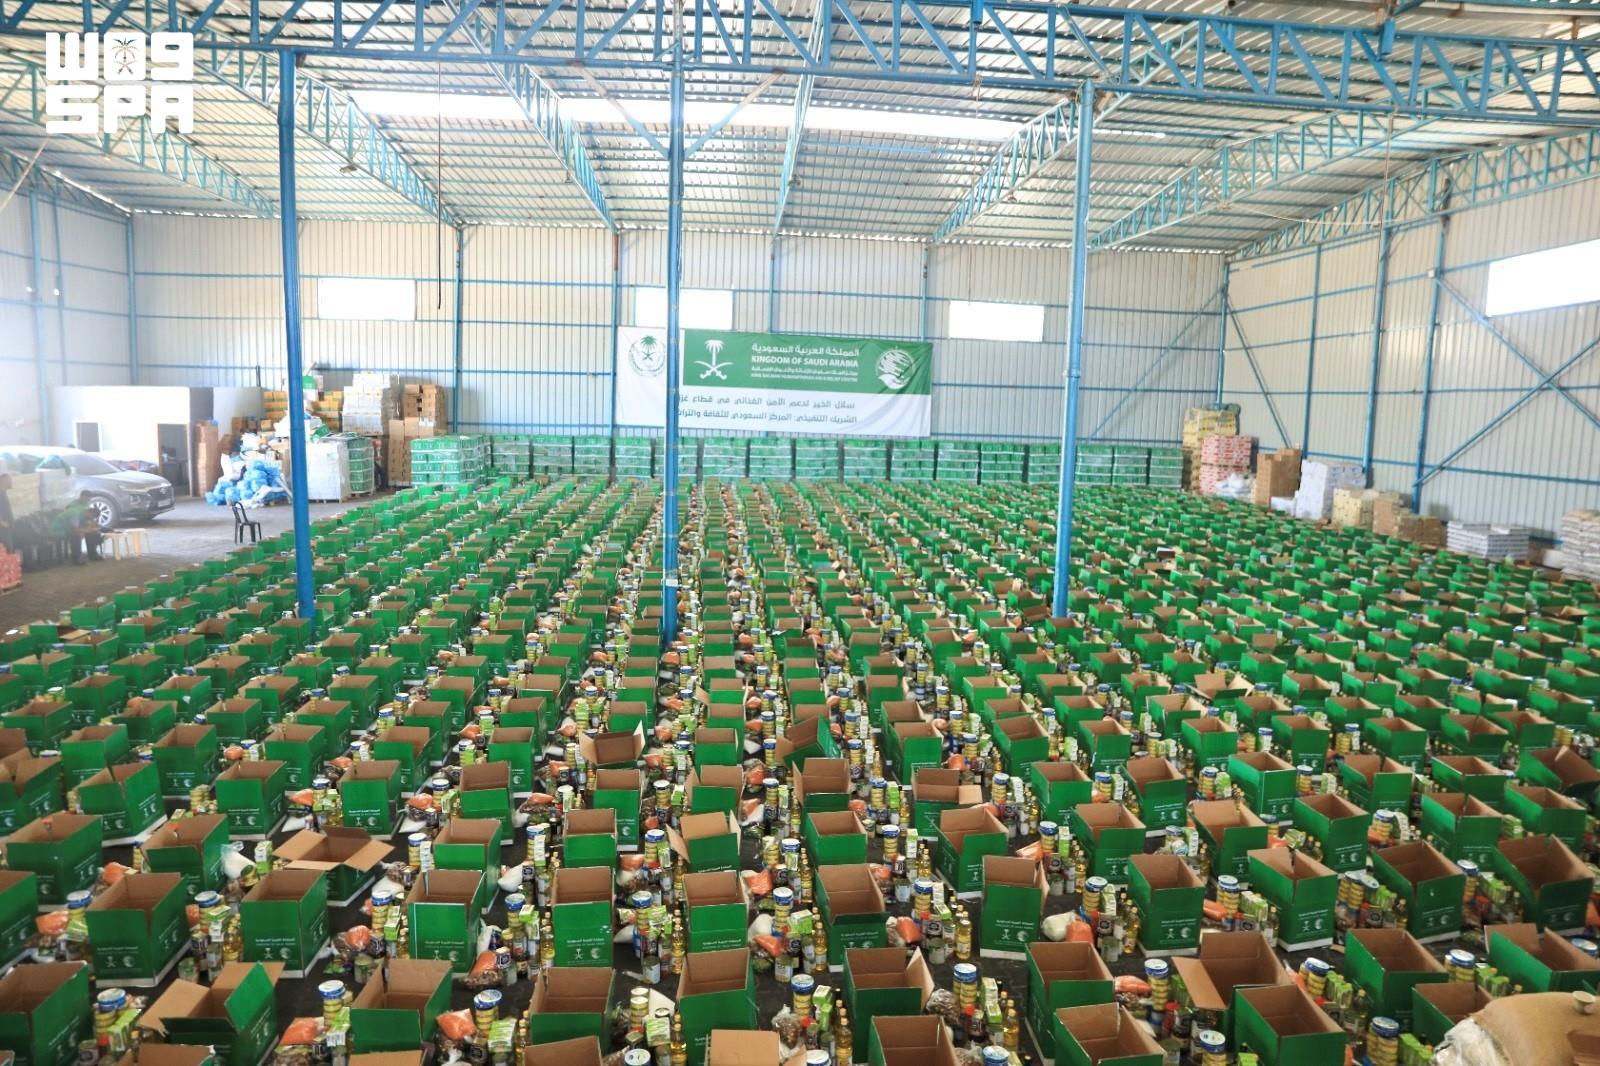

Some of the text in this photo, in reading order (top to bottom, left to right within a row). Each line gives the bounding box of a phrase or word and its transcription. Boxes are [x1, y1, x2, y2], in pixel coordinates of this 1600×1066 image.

[751, 343, 859, 357] المملكة العربية السعودية
[751, 355, 858, 368] KINGDOM OF SAUDI ARABIA
